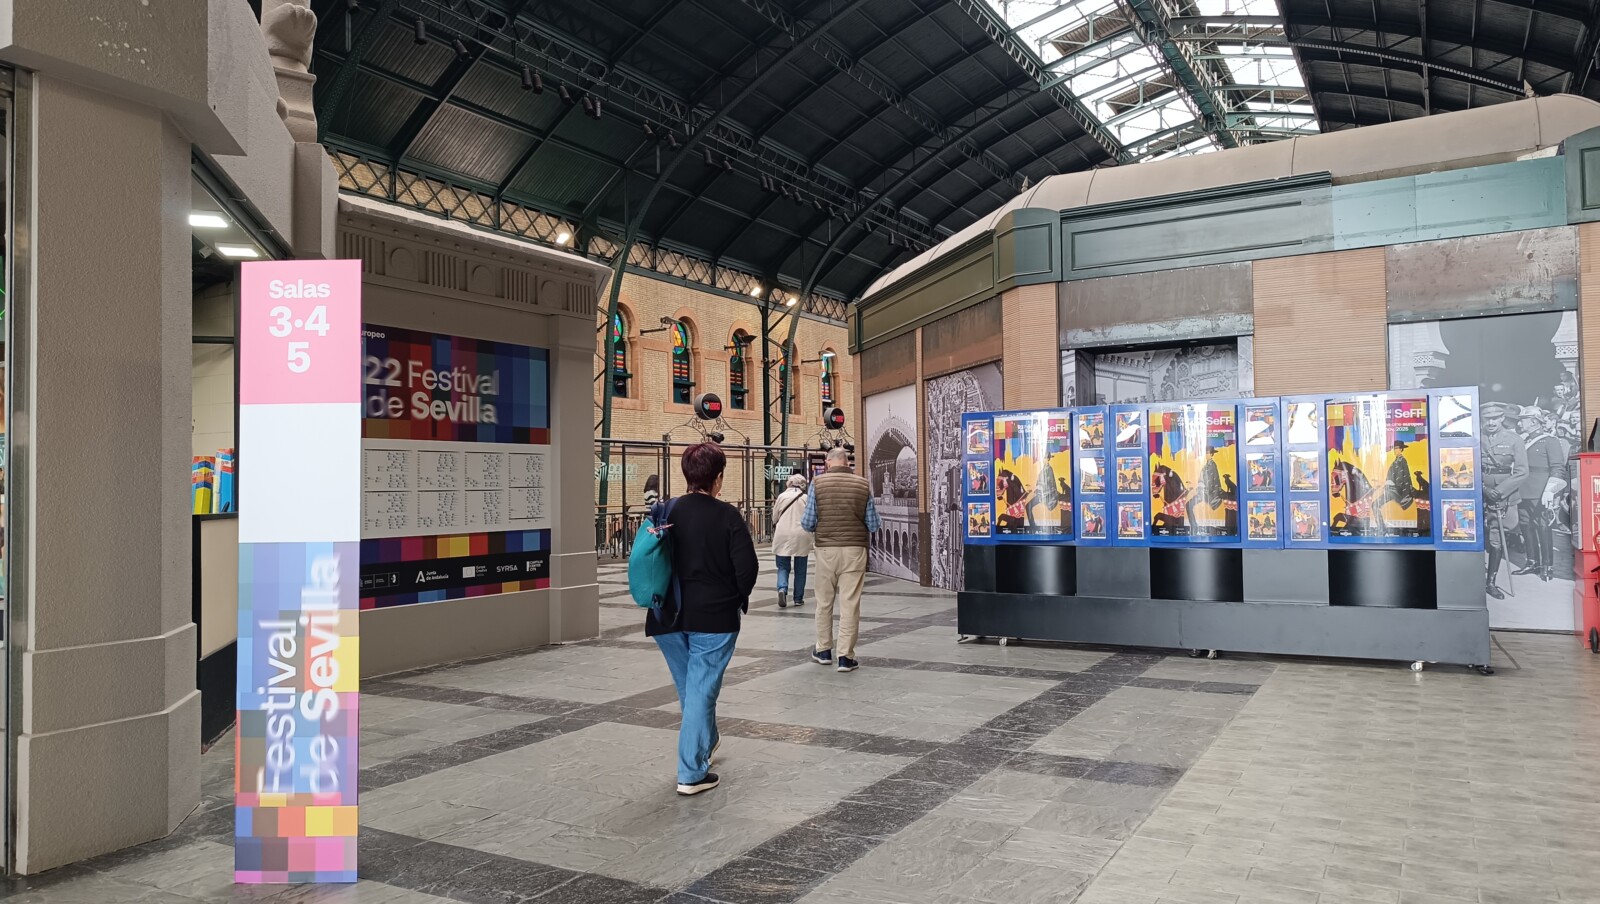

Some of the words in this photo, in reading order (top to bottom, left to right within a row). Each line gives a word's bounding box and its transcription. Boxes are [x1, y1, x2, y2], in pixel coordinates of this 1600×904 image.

[269, 279, 331, 299] Salas
[287, 341, 311, 374] 5
[408, 360, 500, 396] Festival
[367, 388, 404, 418] de
[411, 391, 498, 424] Sevilla
[1394, 408, 1424, 418] SeFF
[496, 564, 519, 573] SYRSA
[300, 553, 341, 722] Sevilla
[257, 619, 297, 797] Festival
[300, 733, 340, 799] de
